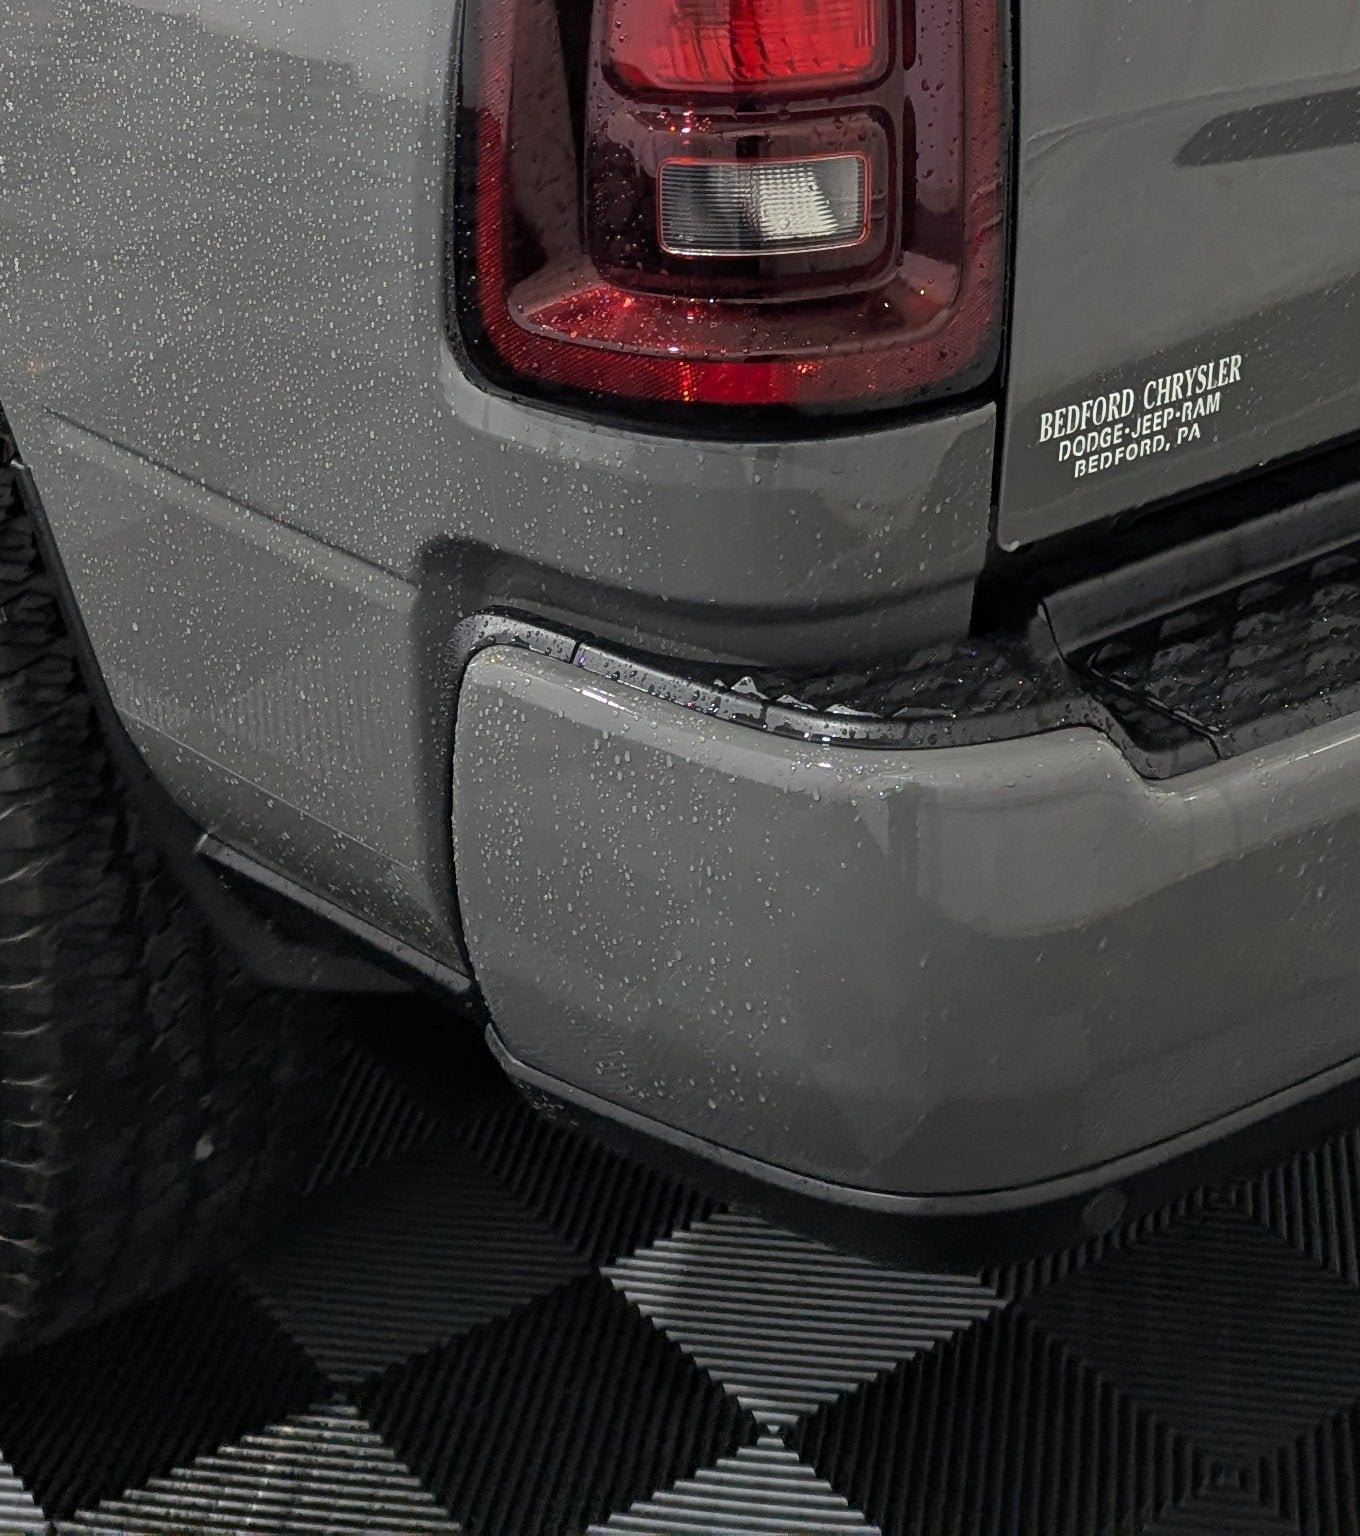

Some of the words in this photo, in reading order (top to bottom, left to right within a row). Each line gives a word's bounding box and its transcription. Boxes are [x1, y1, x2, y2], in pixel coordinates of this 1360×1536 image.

[1039, 388, 1135, 443] BEDFORD
[1143, 353, 1243, 410] CHRYSLER
[1073, 433, 1171, 479] BEDFORD,
[1176, 422, 1201, 445] PA
